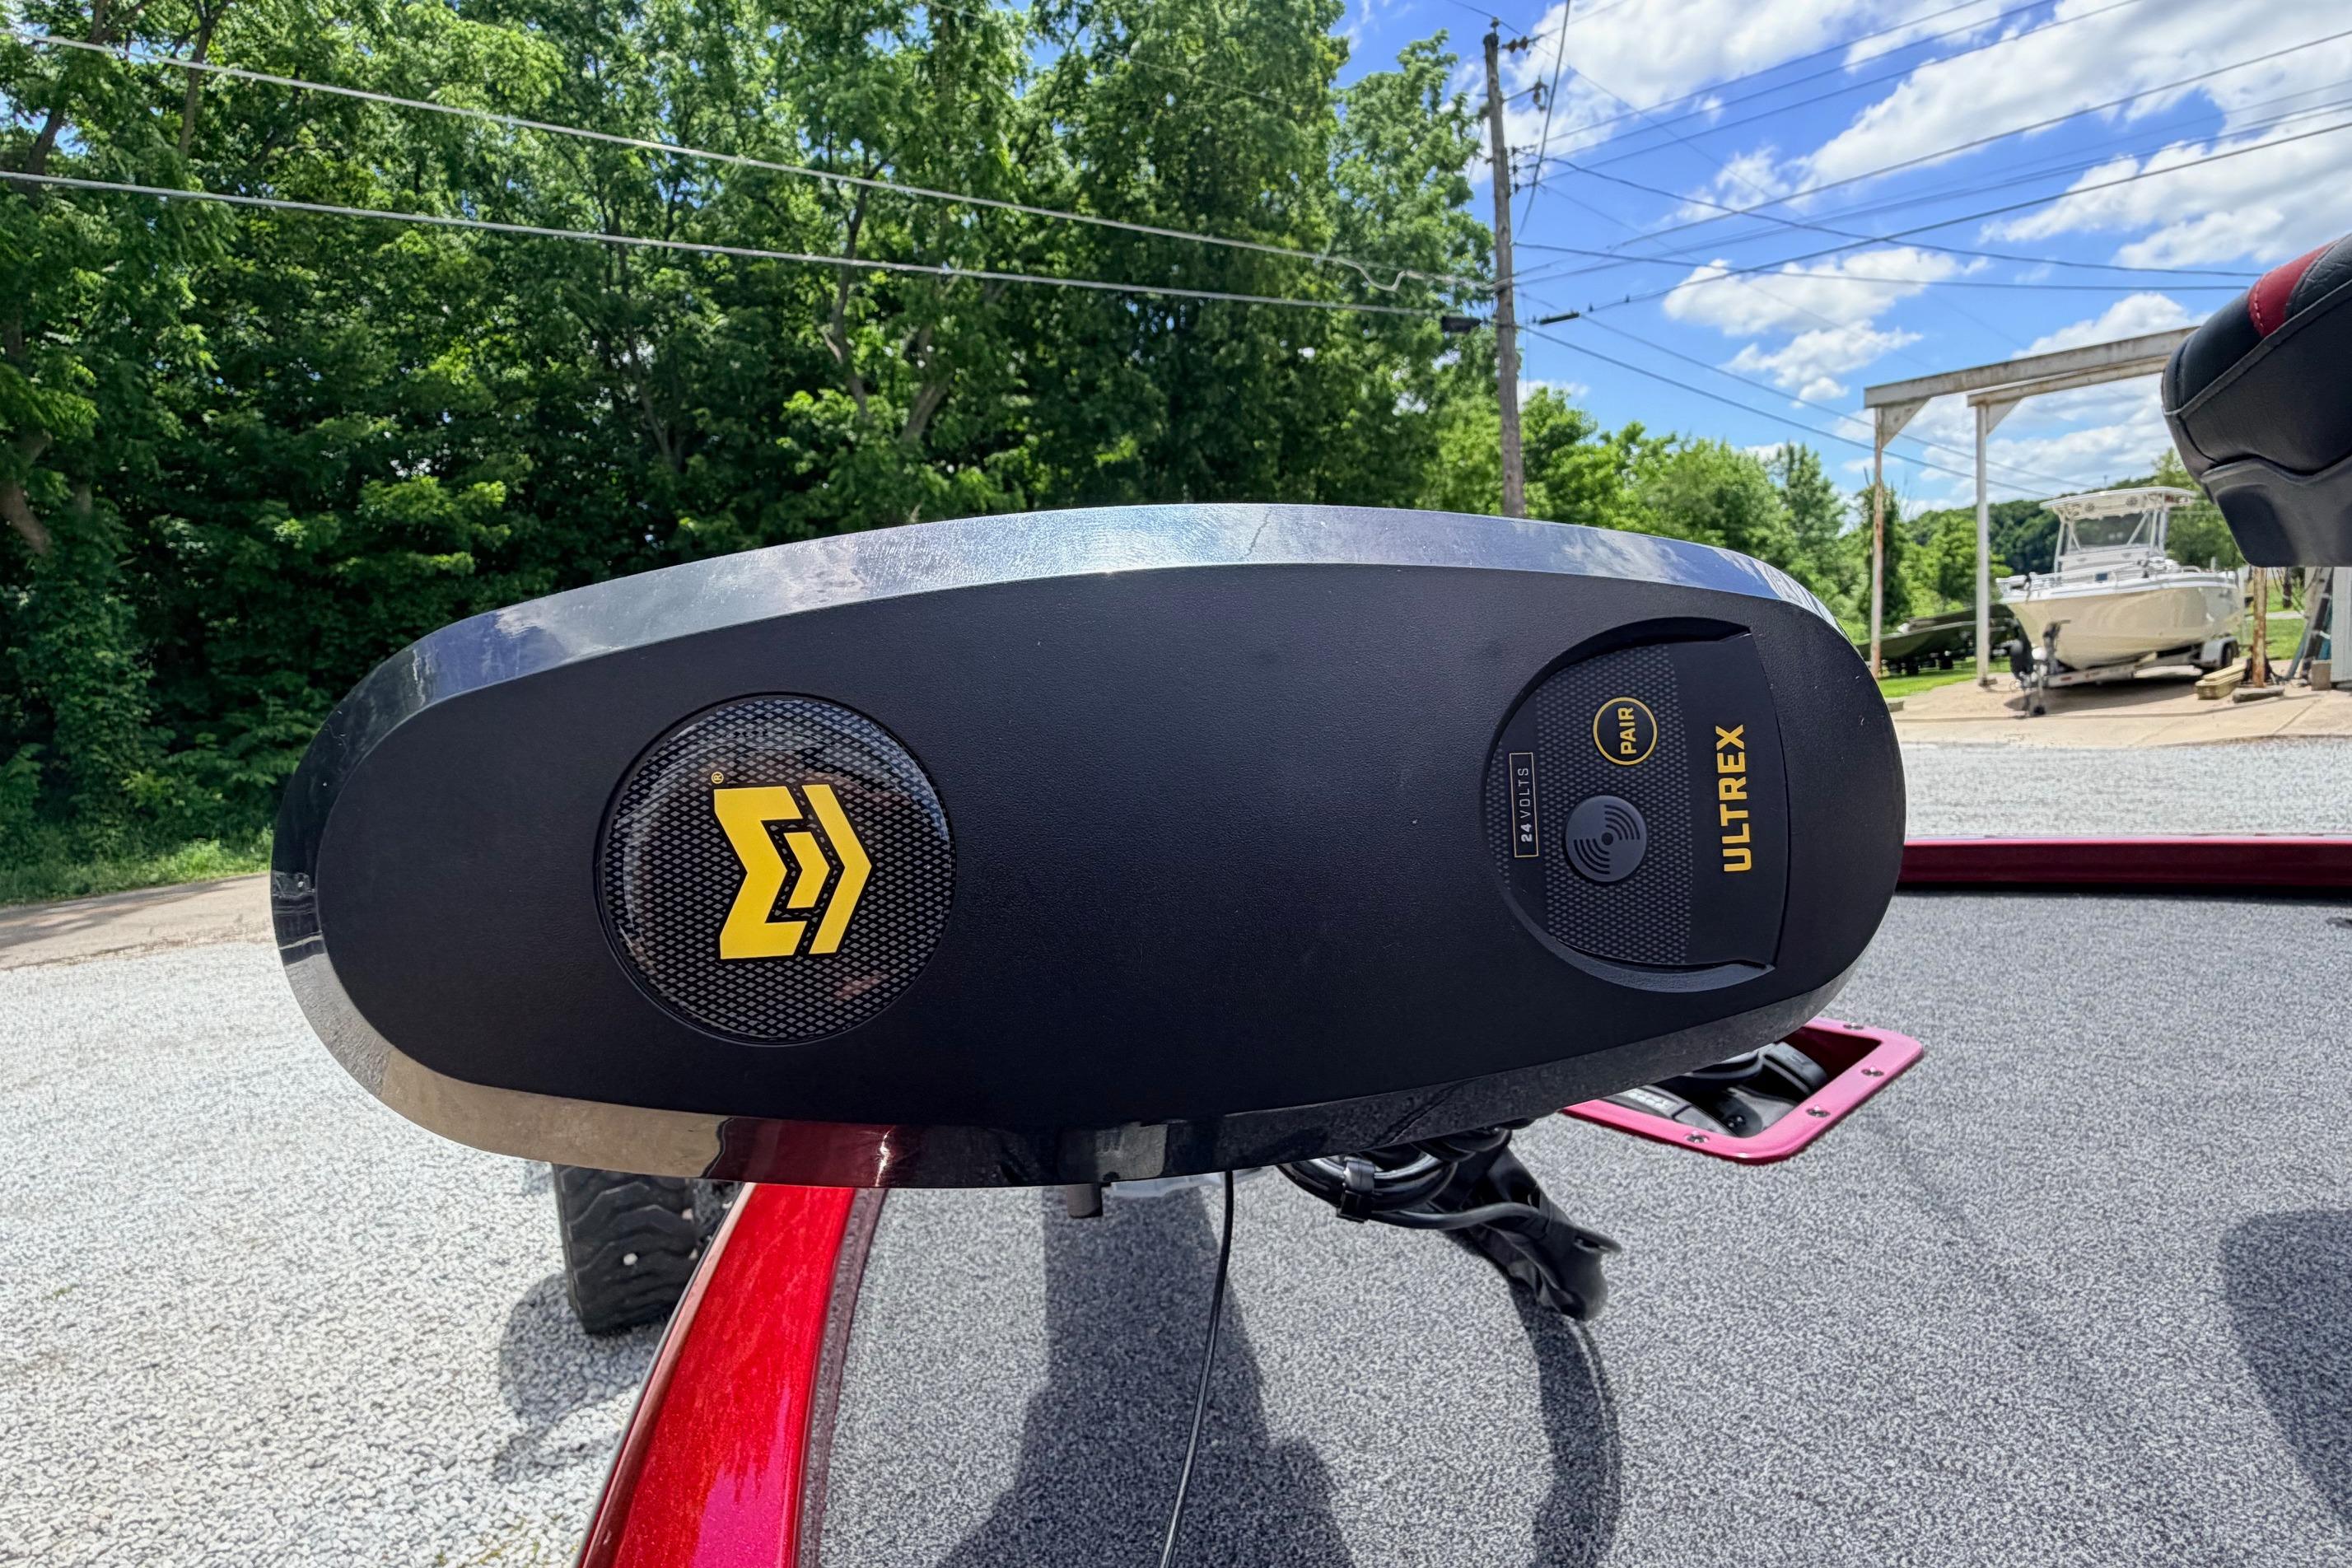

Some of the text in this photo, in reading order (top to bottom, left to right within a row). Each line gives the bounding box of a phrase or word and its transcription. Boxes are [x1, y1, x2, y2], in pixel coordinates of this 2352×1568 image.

[1617, 707, 1637, 754] PAIR
[1517, 767, 1533, 843] 24 VOLTS
[1715, 725, 1752, 872] ULTREX
